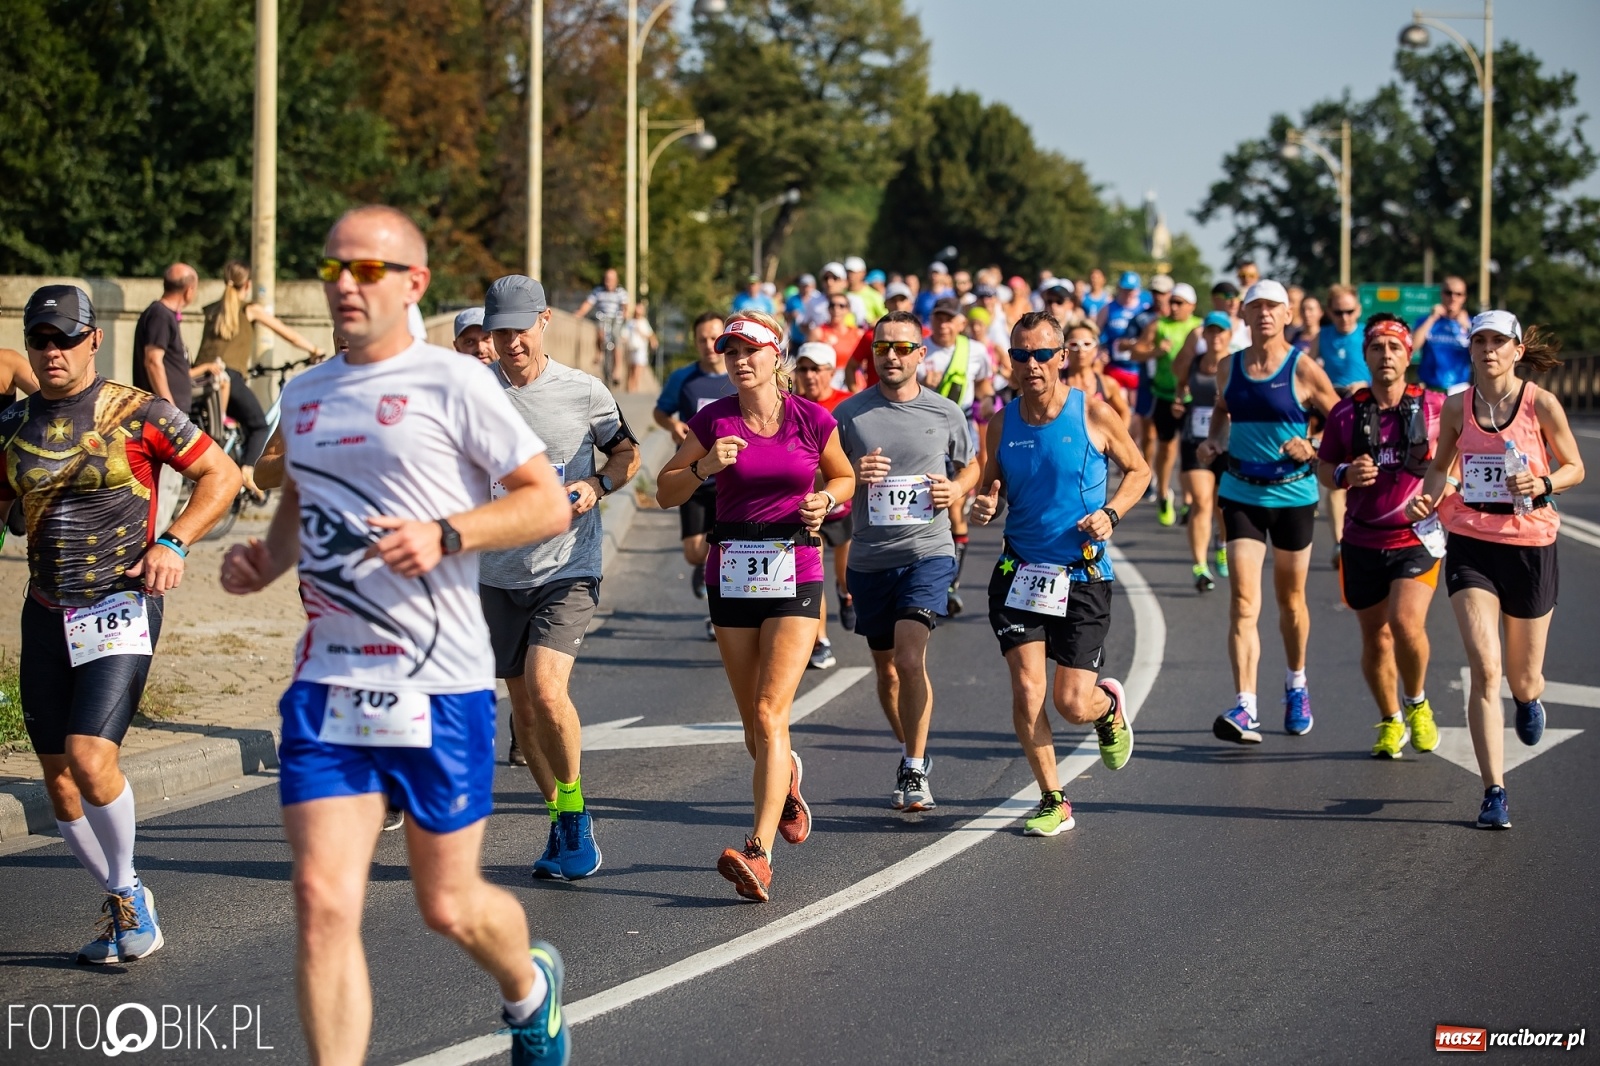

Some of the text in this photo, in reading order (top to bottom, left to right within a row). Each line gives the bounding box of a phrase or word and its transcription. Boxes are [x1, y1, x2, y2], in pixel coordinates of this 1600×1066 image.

[1484, 467, 1507, 482] 37
[888, 490, 918, 506] 192
[747, 557, 769, 575] 31
[1029, 576, 1056, 594] 341
[94, 608, 132, 634] 185
